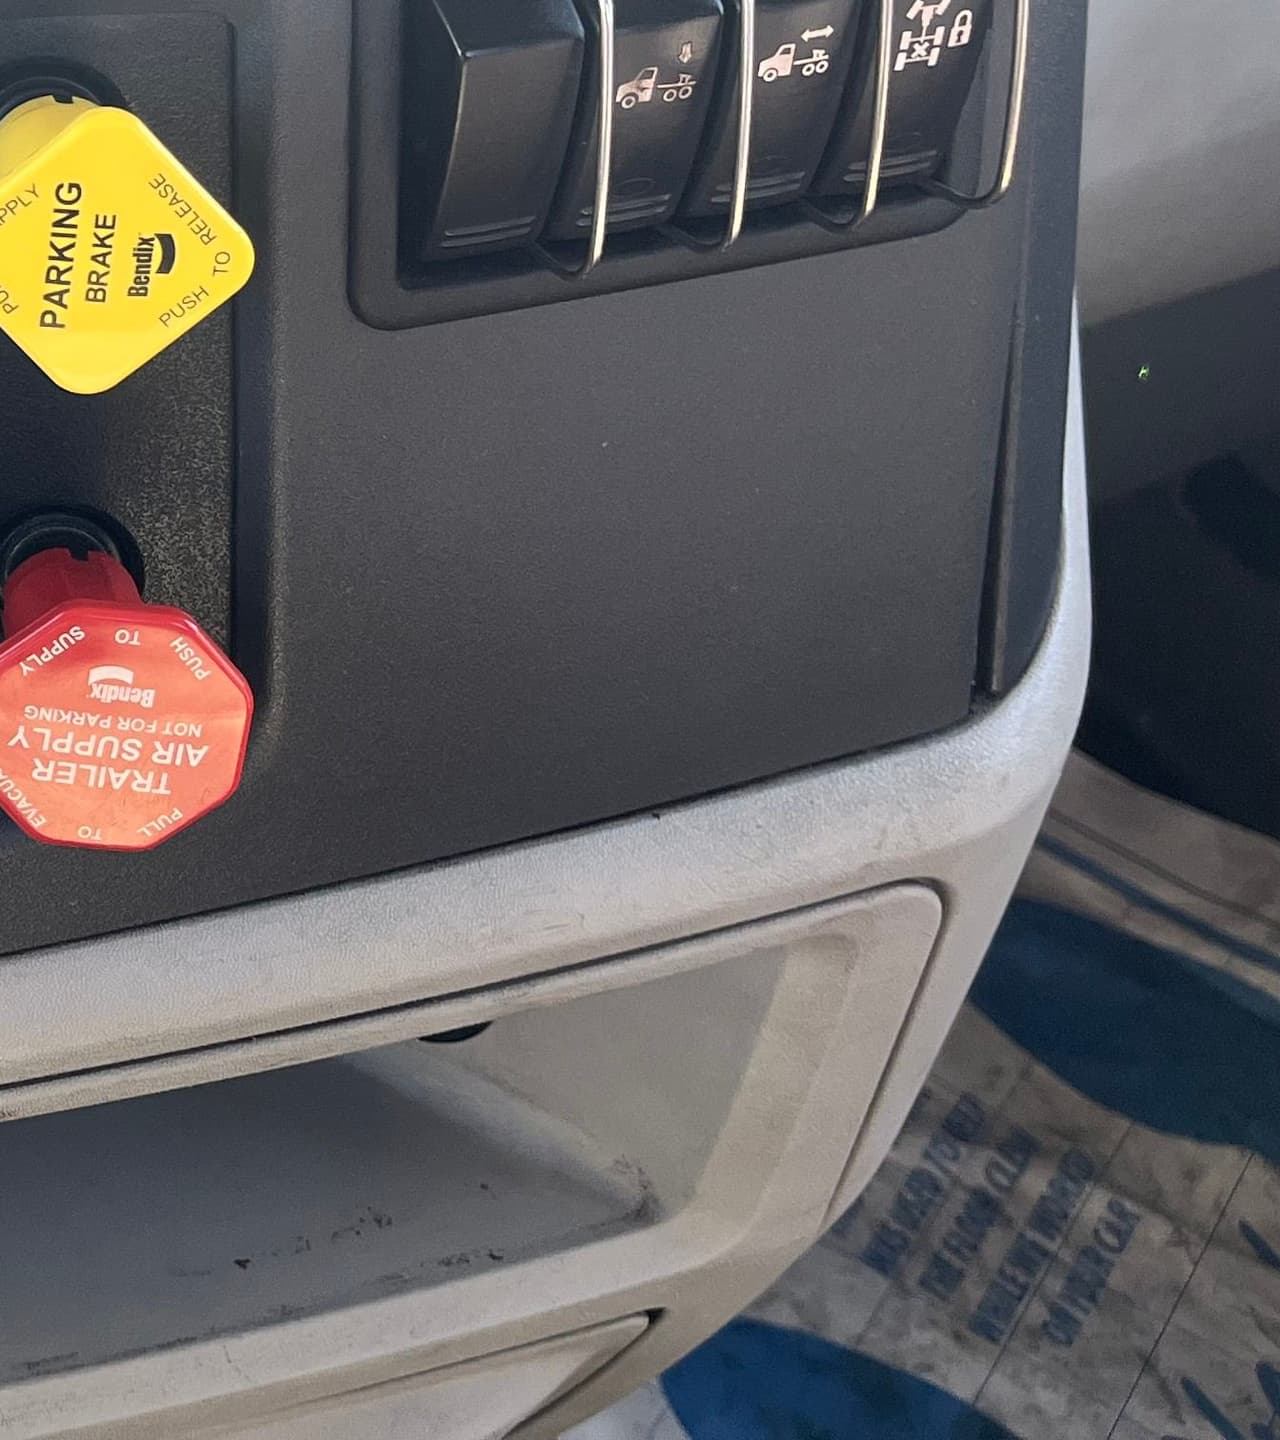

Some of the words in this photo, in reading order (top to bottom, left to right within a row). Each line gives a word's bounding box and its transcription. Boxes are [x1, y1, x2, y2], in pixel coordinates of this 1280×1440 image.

[149, 173, 218, 246] RELEASE
[40, 182, 82, 328] PARKING
[85, 213, 117, 303] BRAKE
[128, 236, 155, 297] Bendix
[213, 251, 231, 276] TO
[158, 285, 209, 328] PUSH
[18, 625, 86, 677] SUPPLY
[114, 628, 141, 646] TO
[169, 636, 211, 681] PUSH
[90, 683, 156, 708] Bendix
[24, 705, 111, 729] PARKING
[118, 715, 157, 733] FOR
[161, 720, 202, 737] NOT
[8, 725, 142, 760] SUPPLY
[151, 741, 209, 768] AIR
[32, 758, 171, 795] TRAILER
[77, 825, 102, 841] TO
[137, 807, 184, 837] PULL
